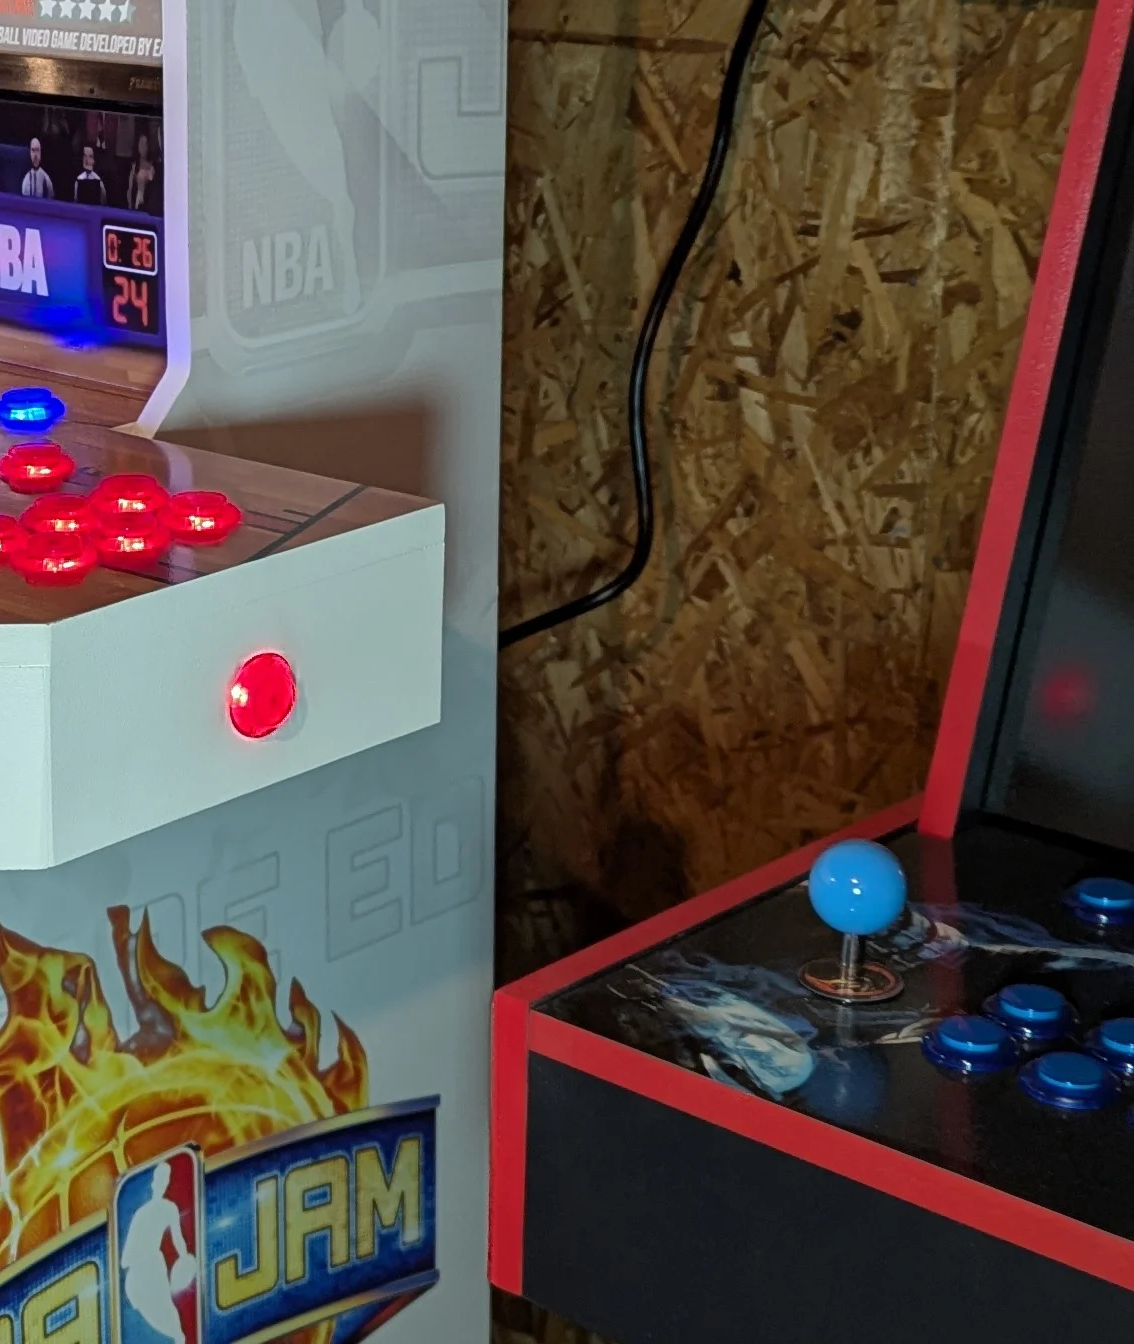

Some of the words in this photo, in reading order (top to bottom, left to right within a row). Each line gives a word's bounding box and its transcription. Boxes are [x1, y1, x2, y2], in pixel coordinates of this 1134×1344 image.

[22, 27, 50, 48] VIDEO
[51, 30, 80, 51] GAME
[80, 33, 136, 56] DEVELOPED
[137, 37, 153, 57] BY
[112, 275, 148, 327] 24
[241, 225, 334, 309] NBA
[213, 1136, 424, 1312] JAM
